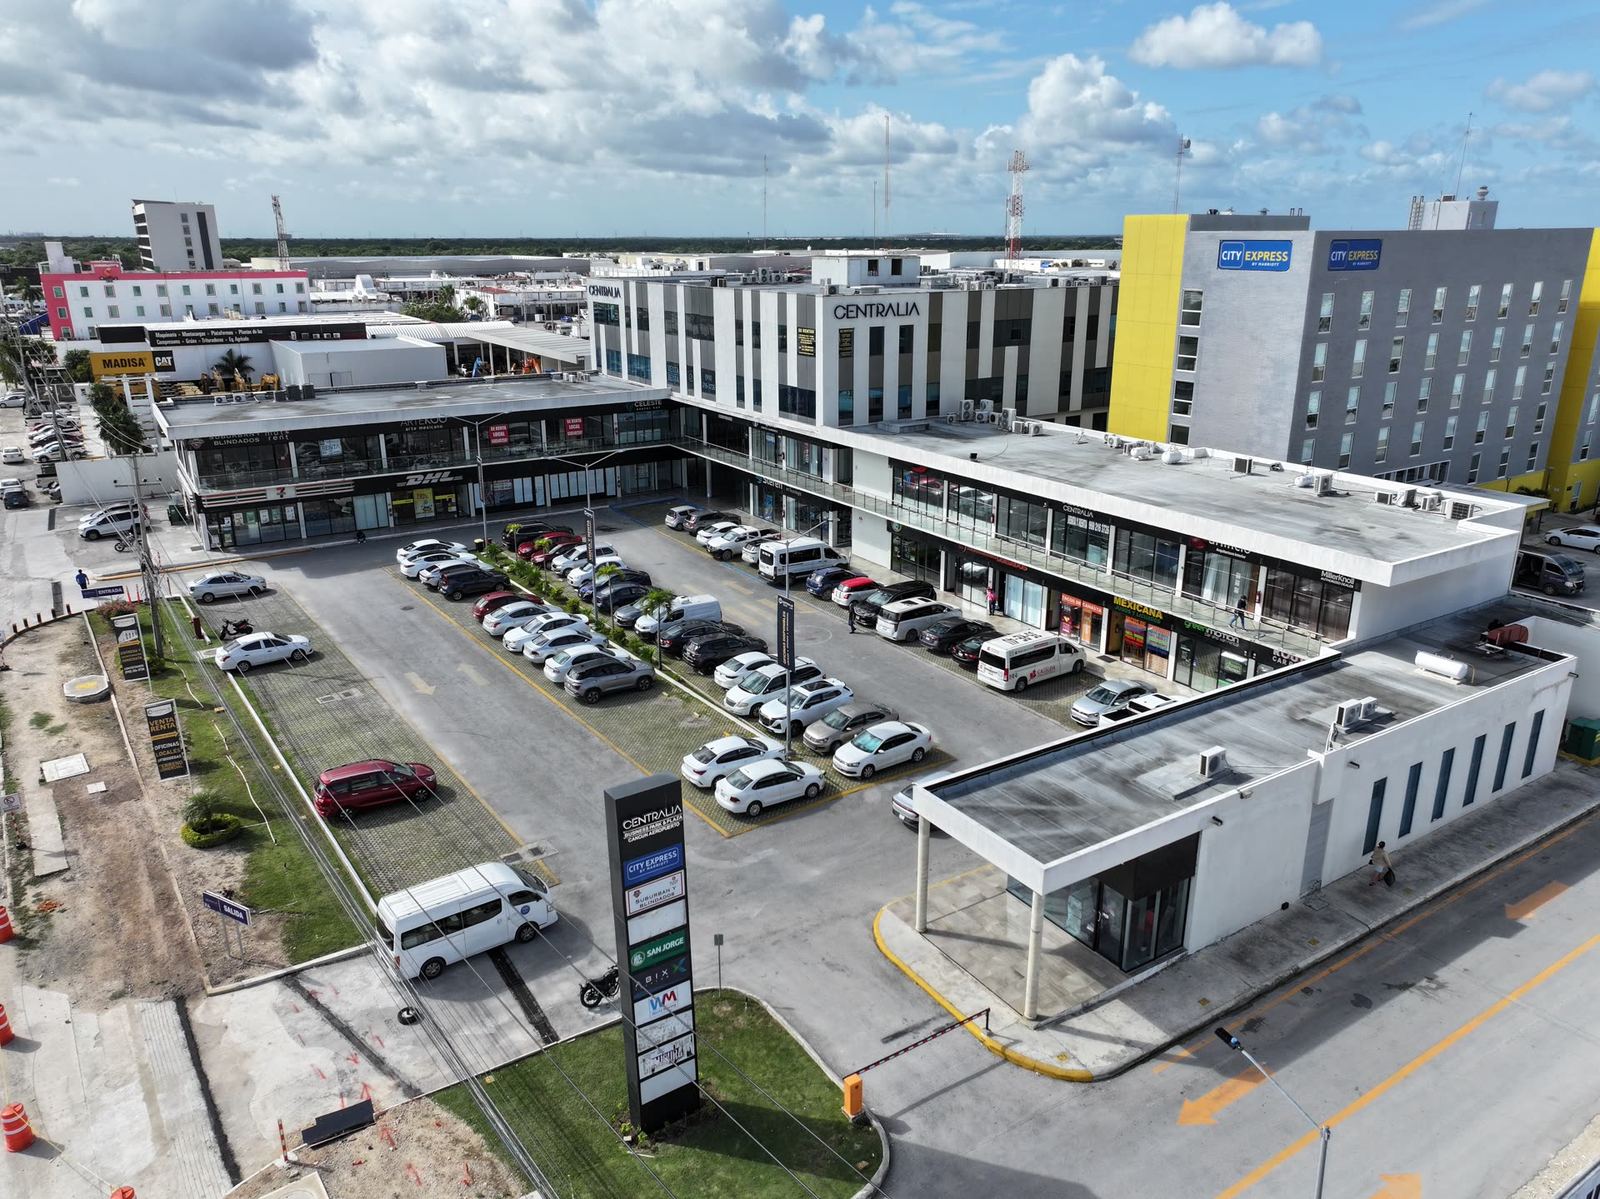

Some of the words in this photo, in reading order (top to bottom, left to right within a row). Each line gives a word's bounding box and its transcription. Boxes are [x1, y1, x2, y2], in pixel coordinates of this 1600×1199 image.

[1222, 250, 1242, 261] CITY
[1245, 251, 1288, 261] EXPRESS
[1331, 251, 1346, 261] CITY
[1349, 250, 1378, 261] EXPRESS
[589, 285, 621, 298] CENTRALIA
[834, 302, 920, 320] CENTRALIA
[103, 357, 145, 368] MADISA
[155, 356, 172, 367] CAT
[213, 437, 260, 446] BLINDADOS
[406, 471, 454, 486] DHL
[1063, 505, 1093, 518] CENTRALIA
[1321, 570, 1355, 585] MillerKnoll
[1113, 596, 1163, 619] MEXICANA
[1272, 655, 1287, 666] CAR
[149, 717, 175, 726] VENTA
[150, 723, 176, 732] RENTA
[155, 741, 179, 750] OFICINAS
[623, 805, 682, 830] CENTRALIA
[649, 822, 662, 831] PARK
[667, 815, 683, 823] PLAZA
[649, 821, 680, 836] AEROPUERTO
[629, 861, 645, 873] CITY
[645, 850, 677, 867] EXPRESS
[635, 889, 671, 905] SUBURBAN
[640, 892, 675, 908] BLINDADOS
[223, 904, 244, 920] SALIDA
[647, 946, 662, 958] SAN
[662, 937, 684, 952] JORGE
